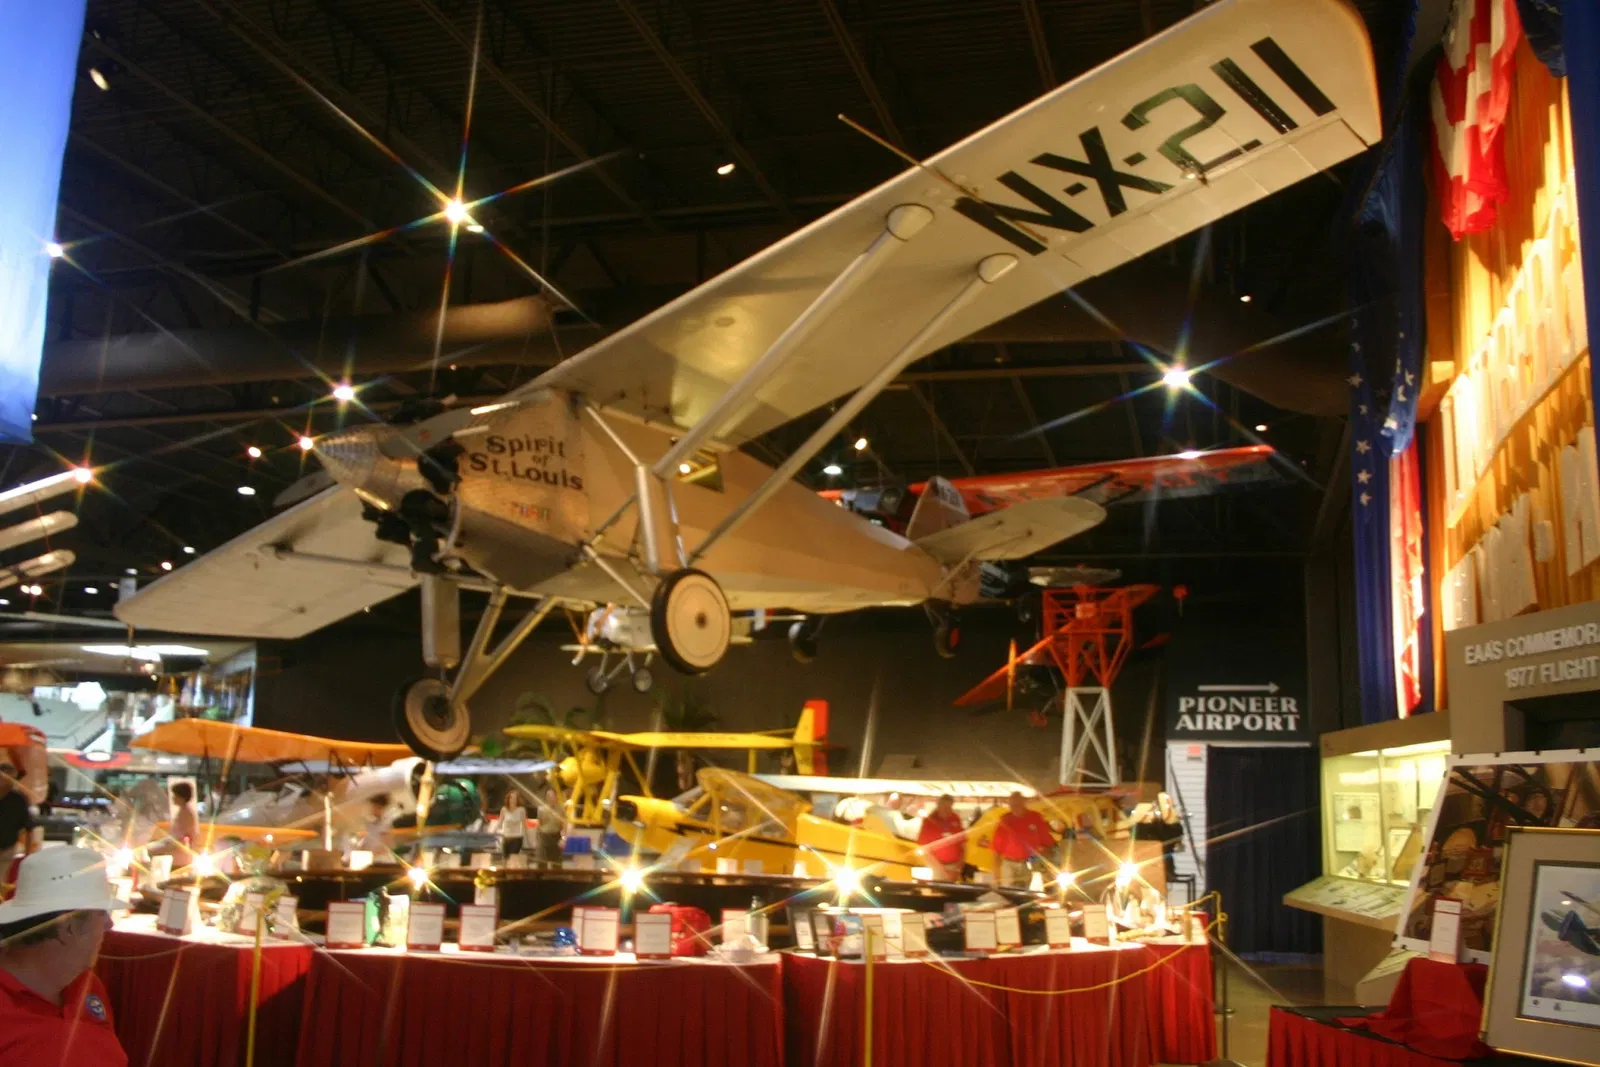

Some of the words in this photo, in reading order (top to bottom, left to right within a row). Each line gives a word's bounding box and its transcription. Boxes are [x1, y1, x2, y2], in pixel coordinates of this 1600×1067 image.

[486, 434, 565, 458] Spirit
[1505, 622, 1600, 657] COMMEMOR
[1505, 665, 1538, 688] 1977
[1540, 655, 1600, 684] FLIGHT
[1178, 696, 1299, 713] PIONEER
[1175, 713, 1301, 731] AIRPORT
